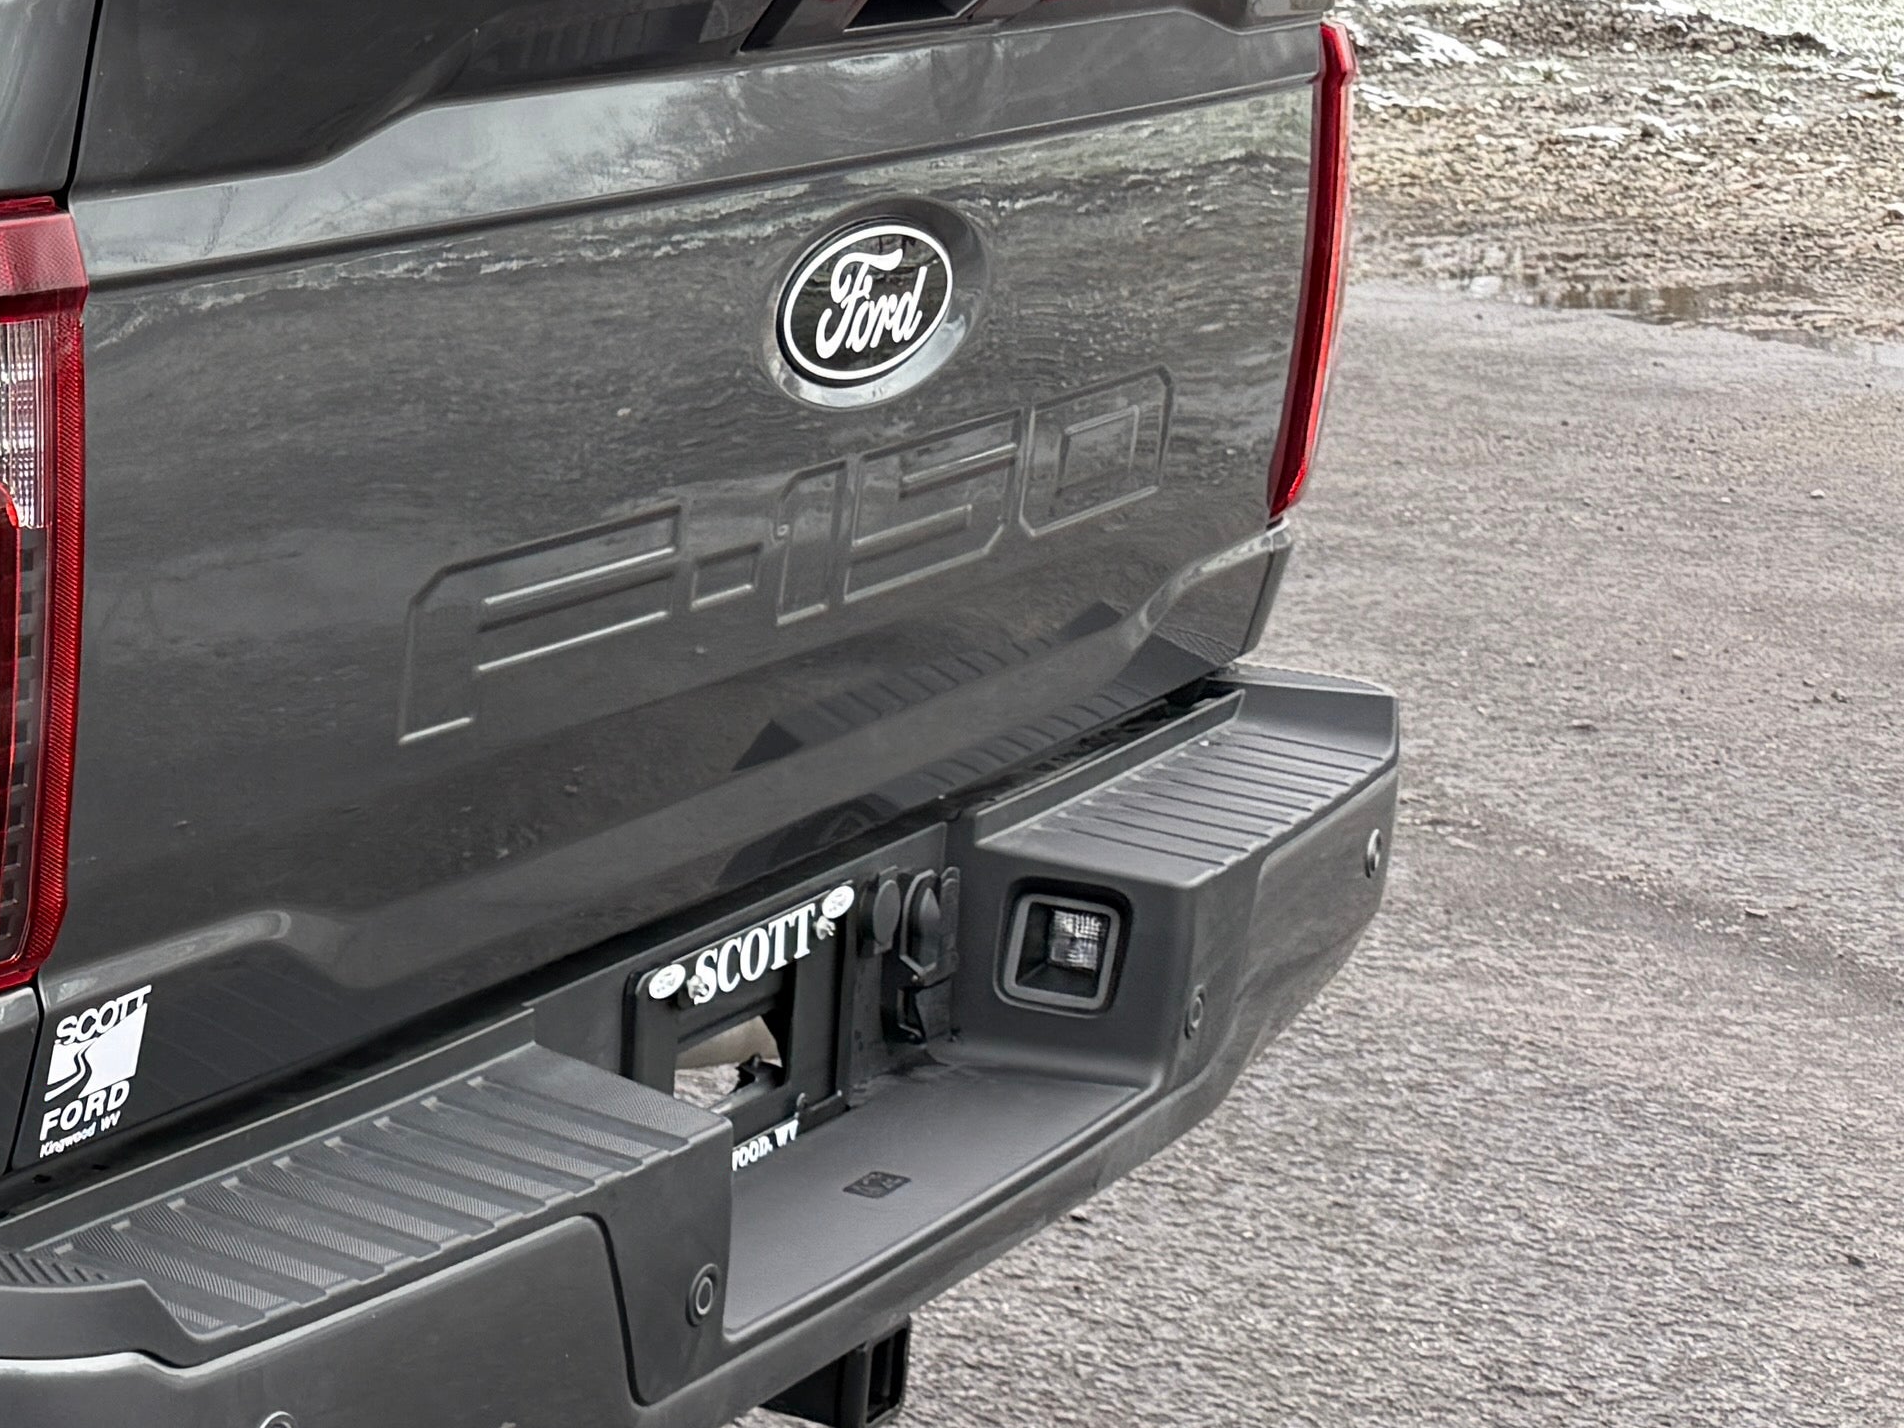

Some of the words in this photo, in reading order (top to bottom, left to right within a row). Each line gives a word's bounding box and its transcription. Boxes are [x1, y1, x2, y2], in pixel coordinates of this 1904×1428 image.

[815, 248, 928, 360] Ford
[398, 364, 1176, 746] F-150
[692, 902, 817, 1006] SCOTT
[54, 984, 153, 1046] SCOTT
[39, 1080, 131, 1141] FORD
[39, 1121, 97, 1159] Kingwood
[100, 1110, 122, 1132] WV
[775, 1118, 799, 1148] WV
